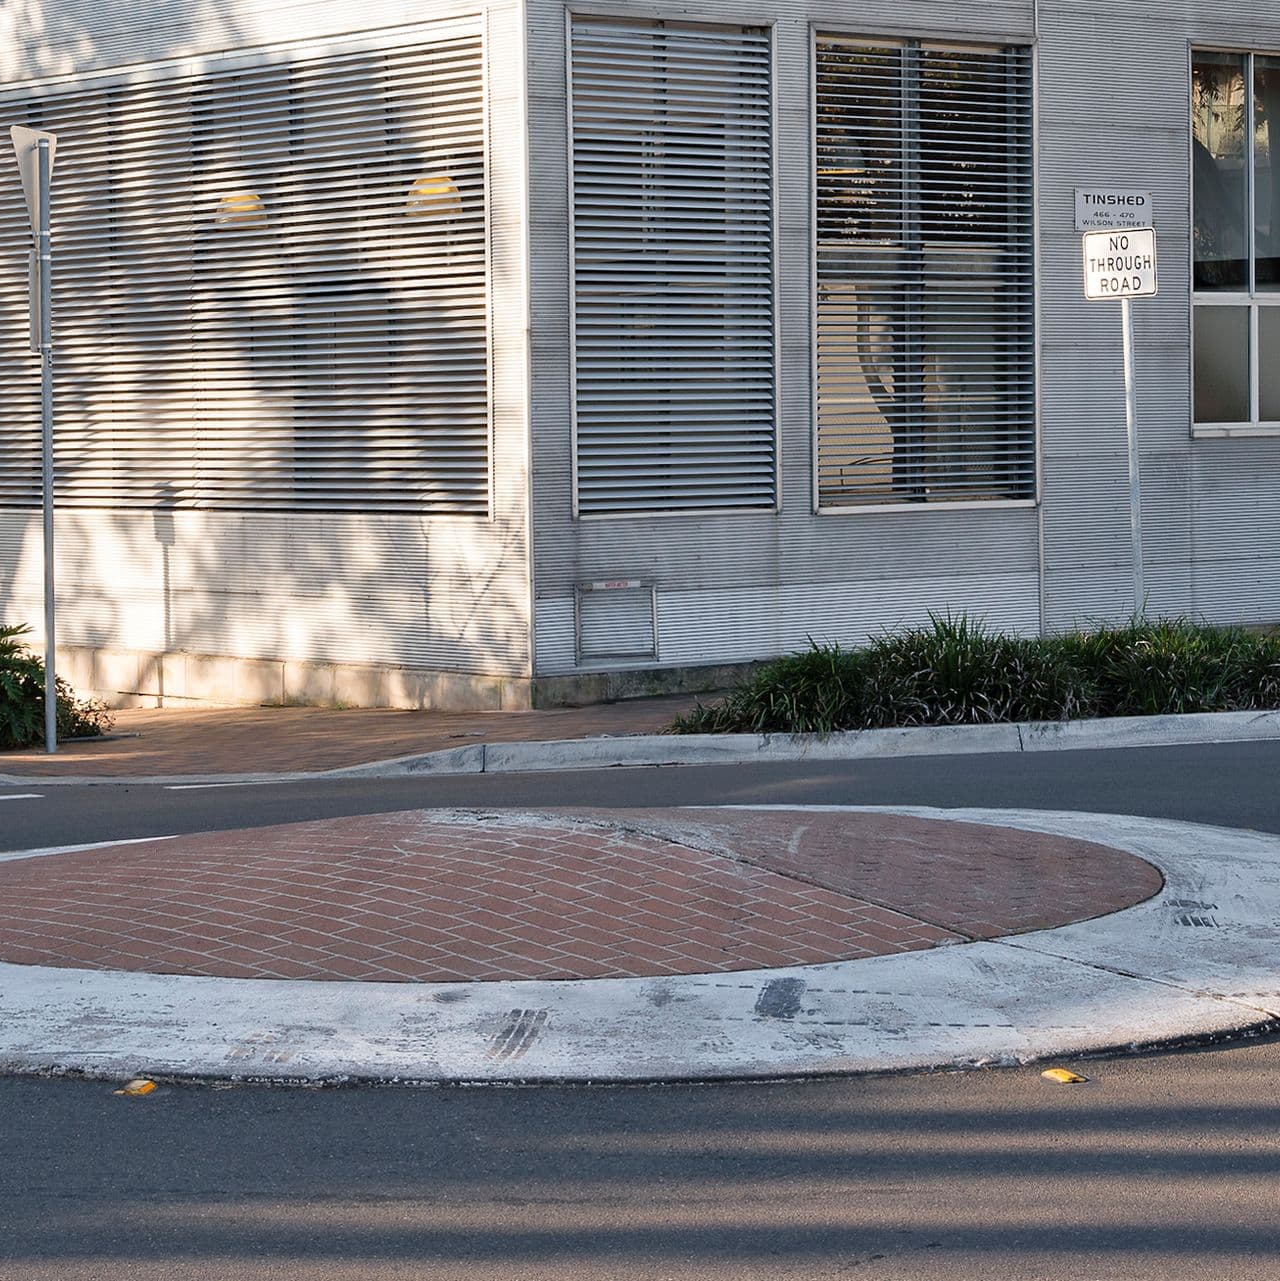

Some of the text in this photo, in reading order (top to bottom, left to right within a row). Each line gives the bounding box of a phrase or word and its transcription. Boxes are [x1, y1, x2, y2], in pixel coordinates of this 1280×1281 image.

[1083, 194, 1145, 206] TINSHED
[1109, 235, 1129, 251] NO
[1090, 255, 1151, 273] THROUGH
[1100, 276, 1142, 293] ROAD
